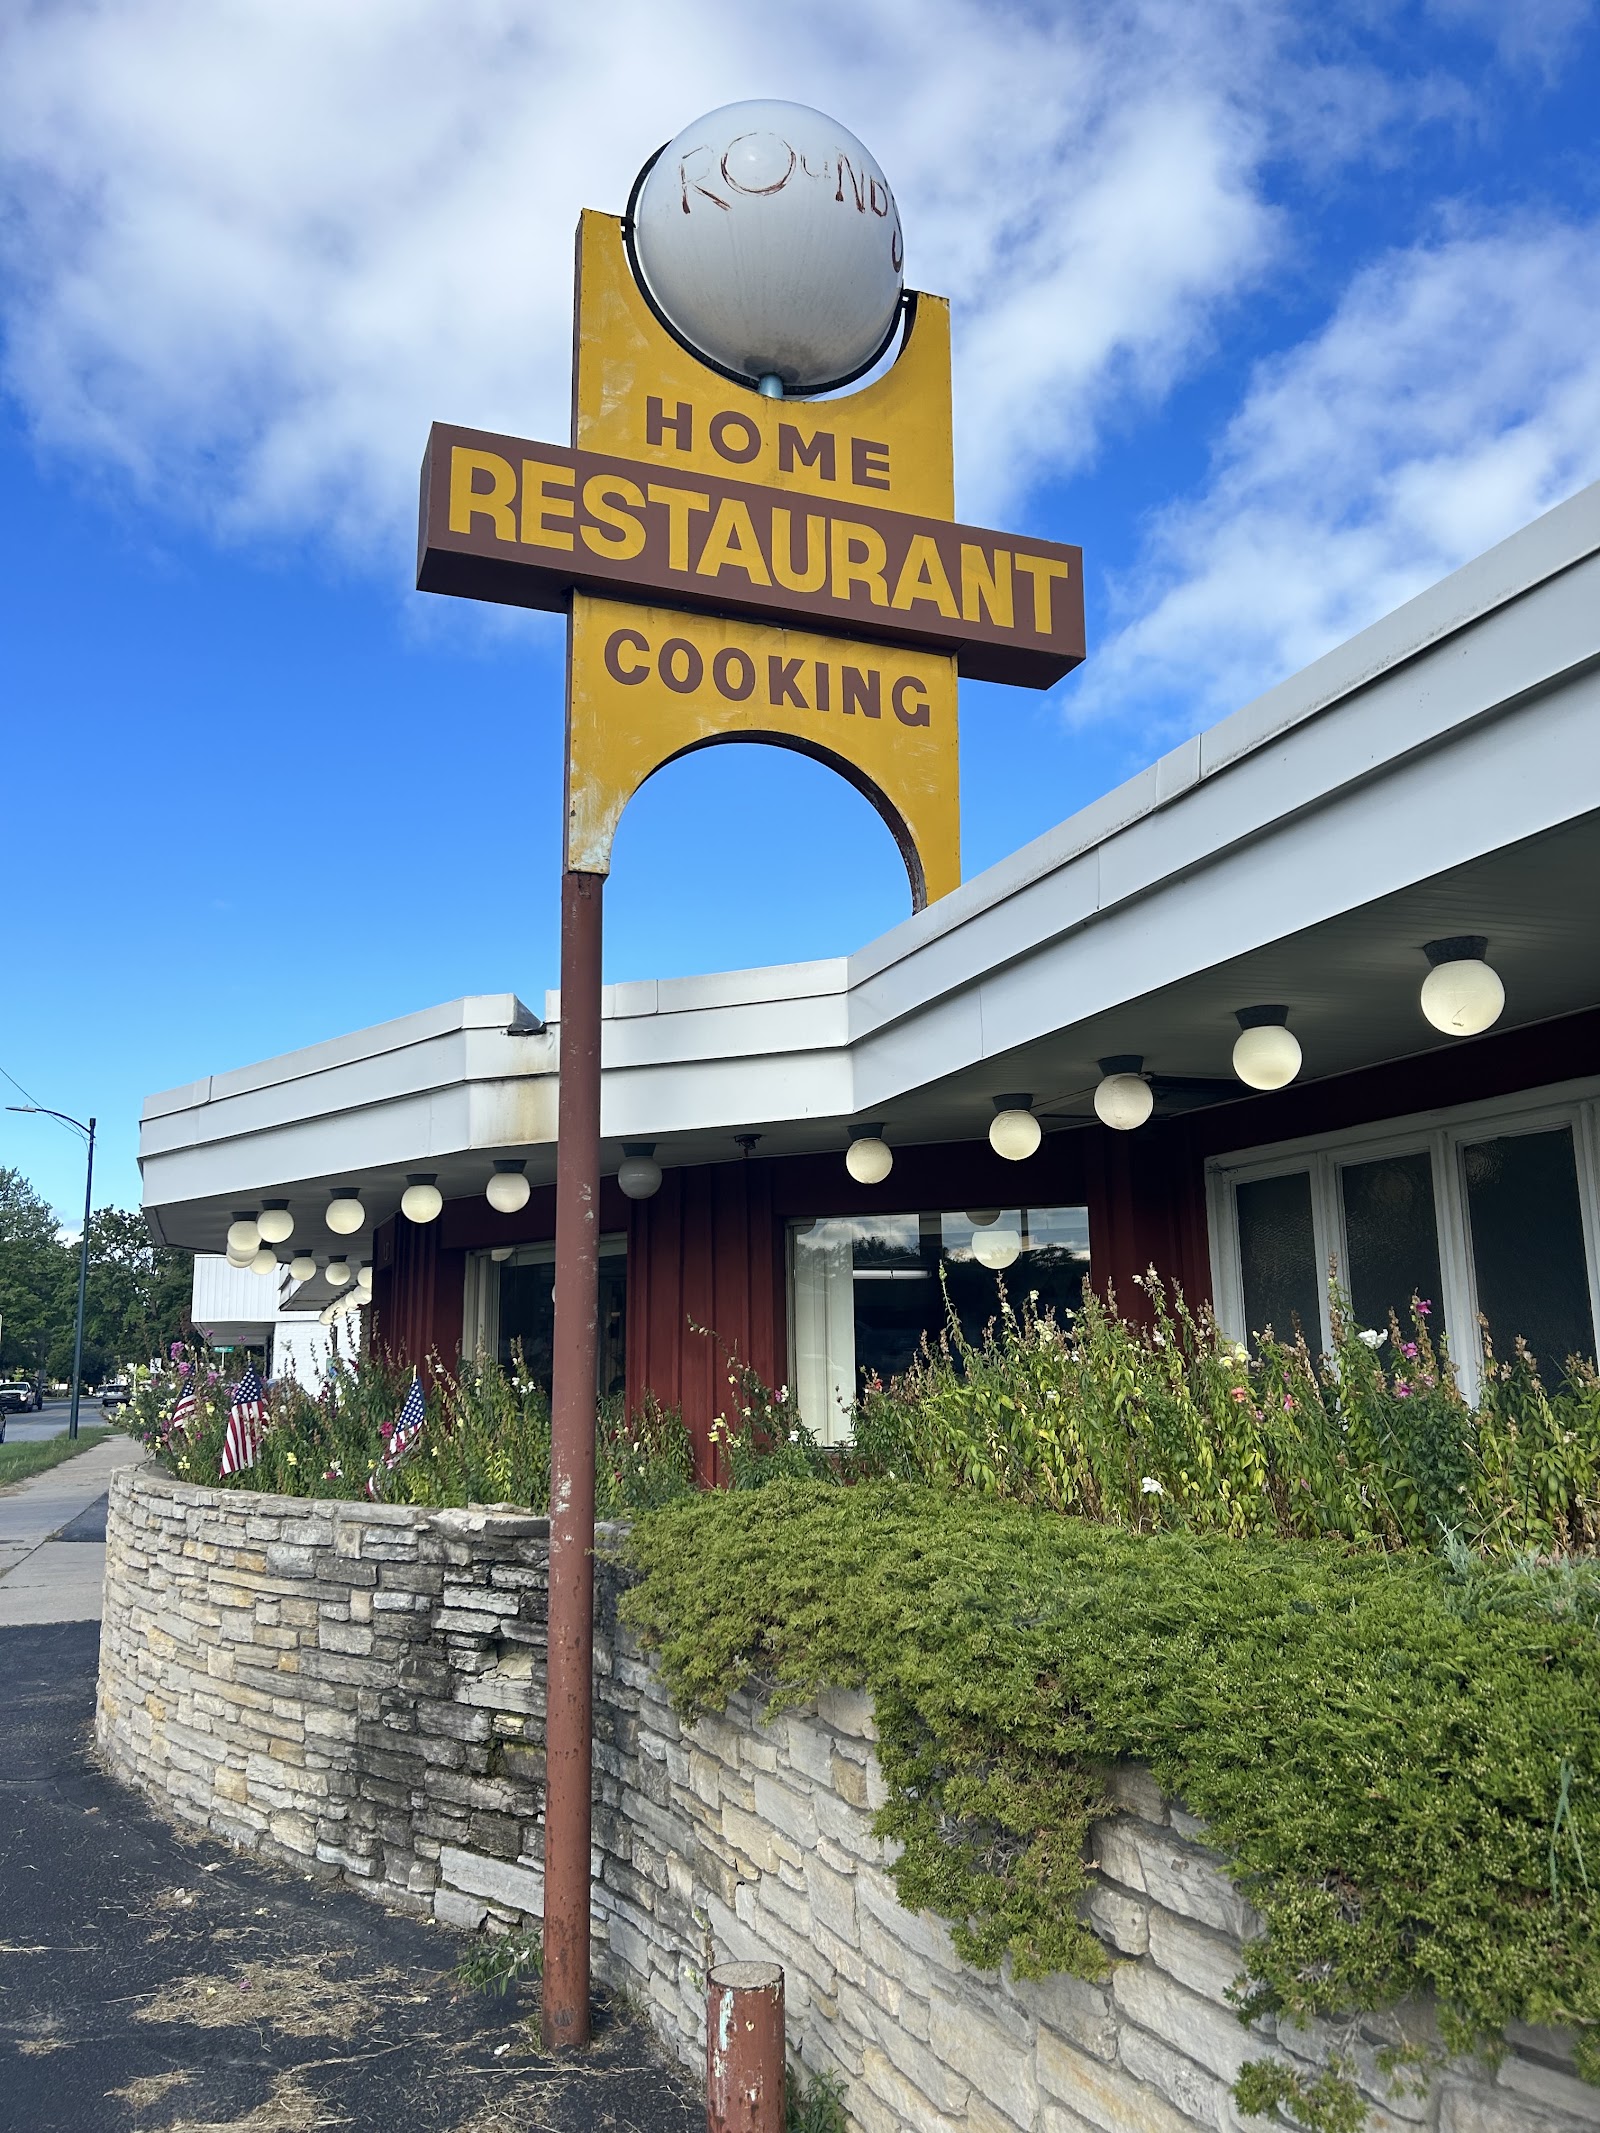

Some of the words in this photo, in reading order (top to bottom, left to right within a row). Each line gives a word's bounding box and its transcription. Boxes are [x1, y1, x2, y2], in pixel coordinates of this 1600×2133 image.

[646, 395, 891, 491] HOME
[449, 445, 1068, 635] RESTAURANT
[604, 628, 931, 727] COOKING
